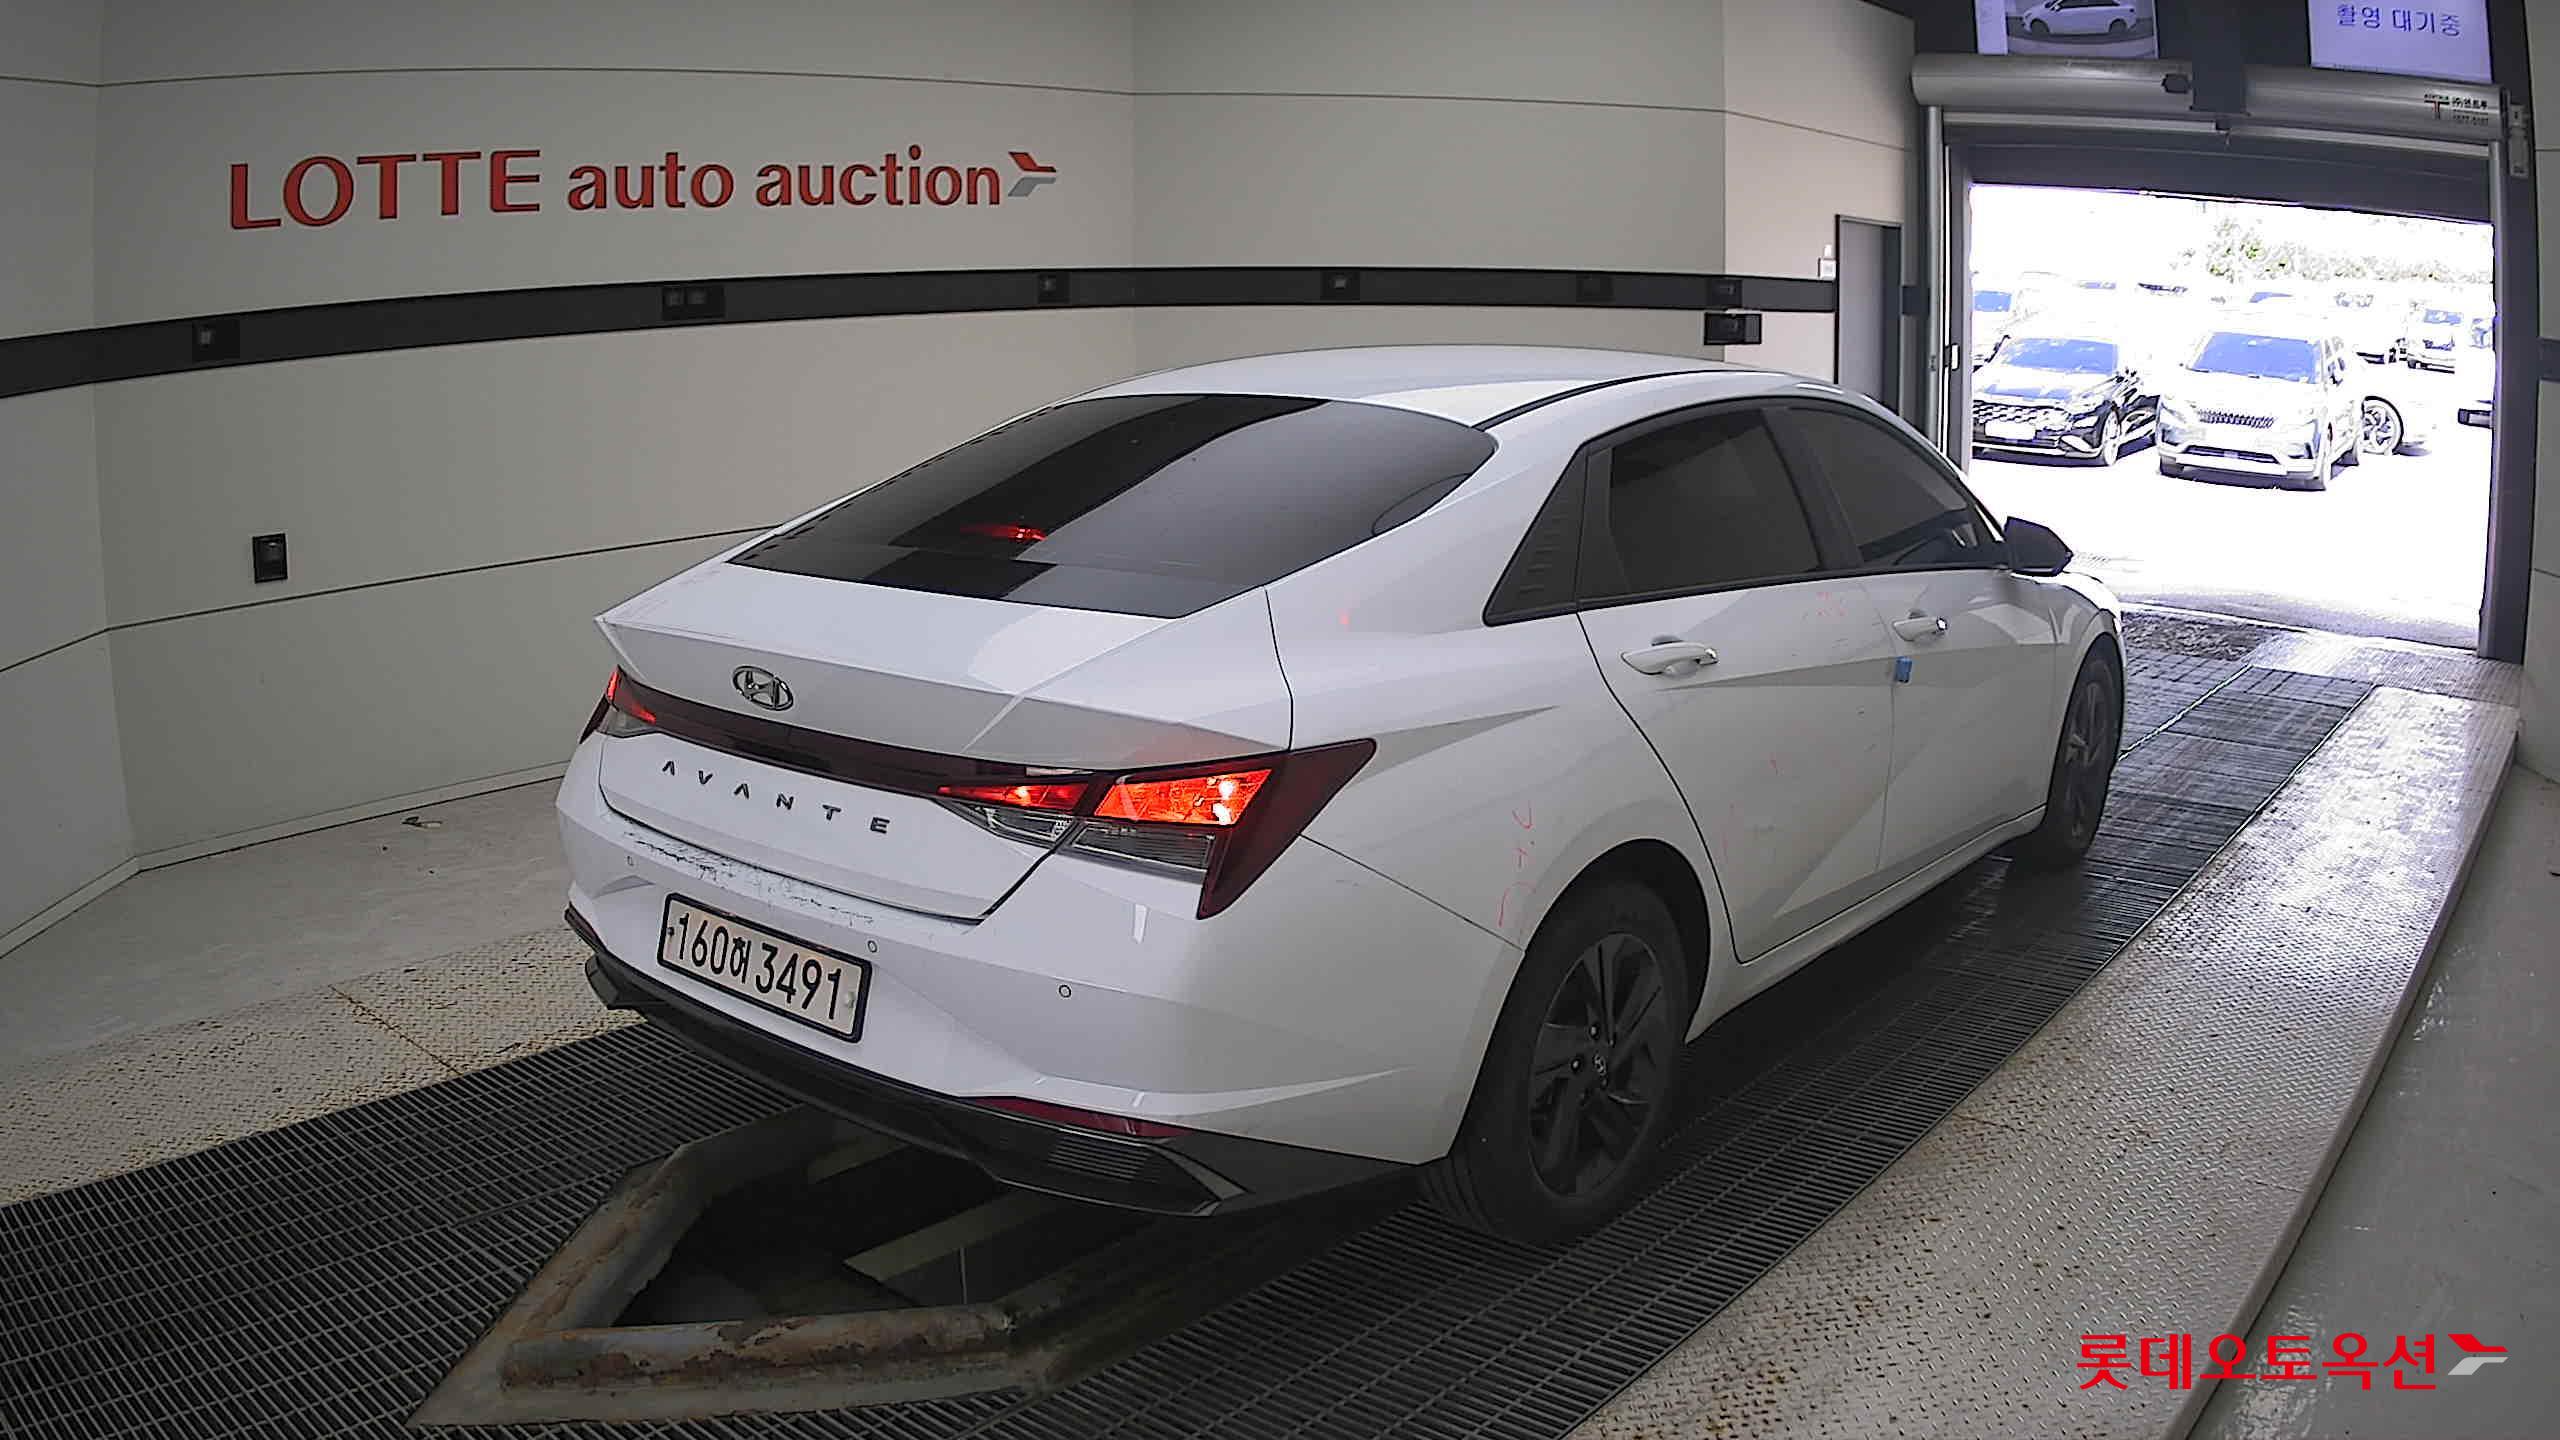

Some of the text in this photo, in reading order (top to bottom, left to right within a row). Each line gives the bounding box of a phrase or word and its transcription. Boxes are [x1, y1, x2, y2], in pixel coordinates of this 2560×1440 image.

[2337, 4, 2460, 37] 촬영 대기중
[229, 145, 1002, 231] LOTTE auto auction
[661, 759, 891, 835] AVANTE
